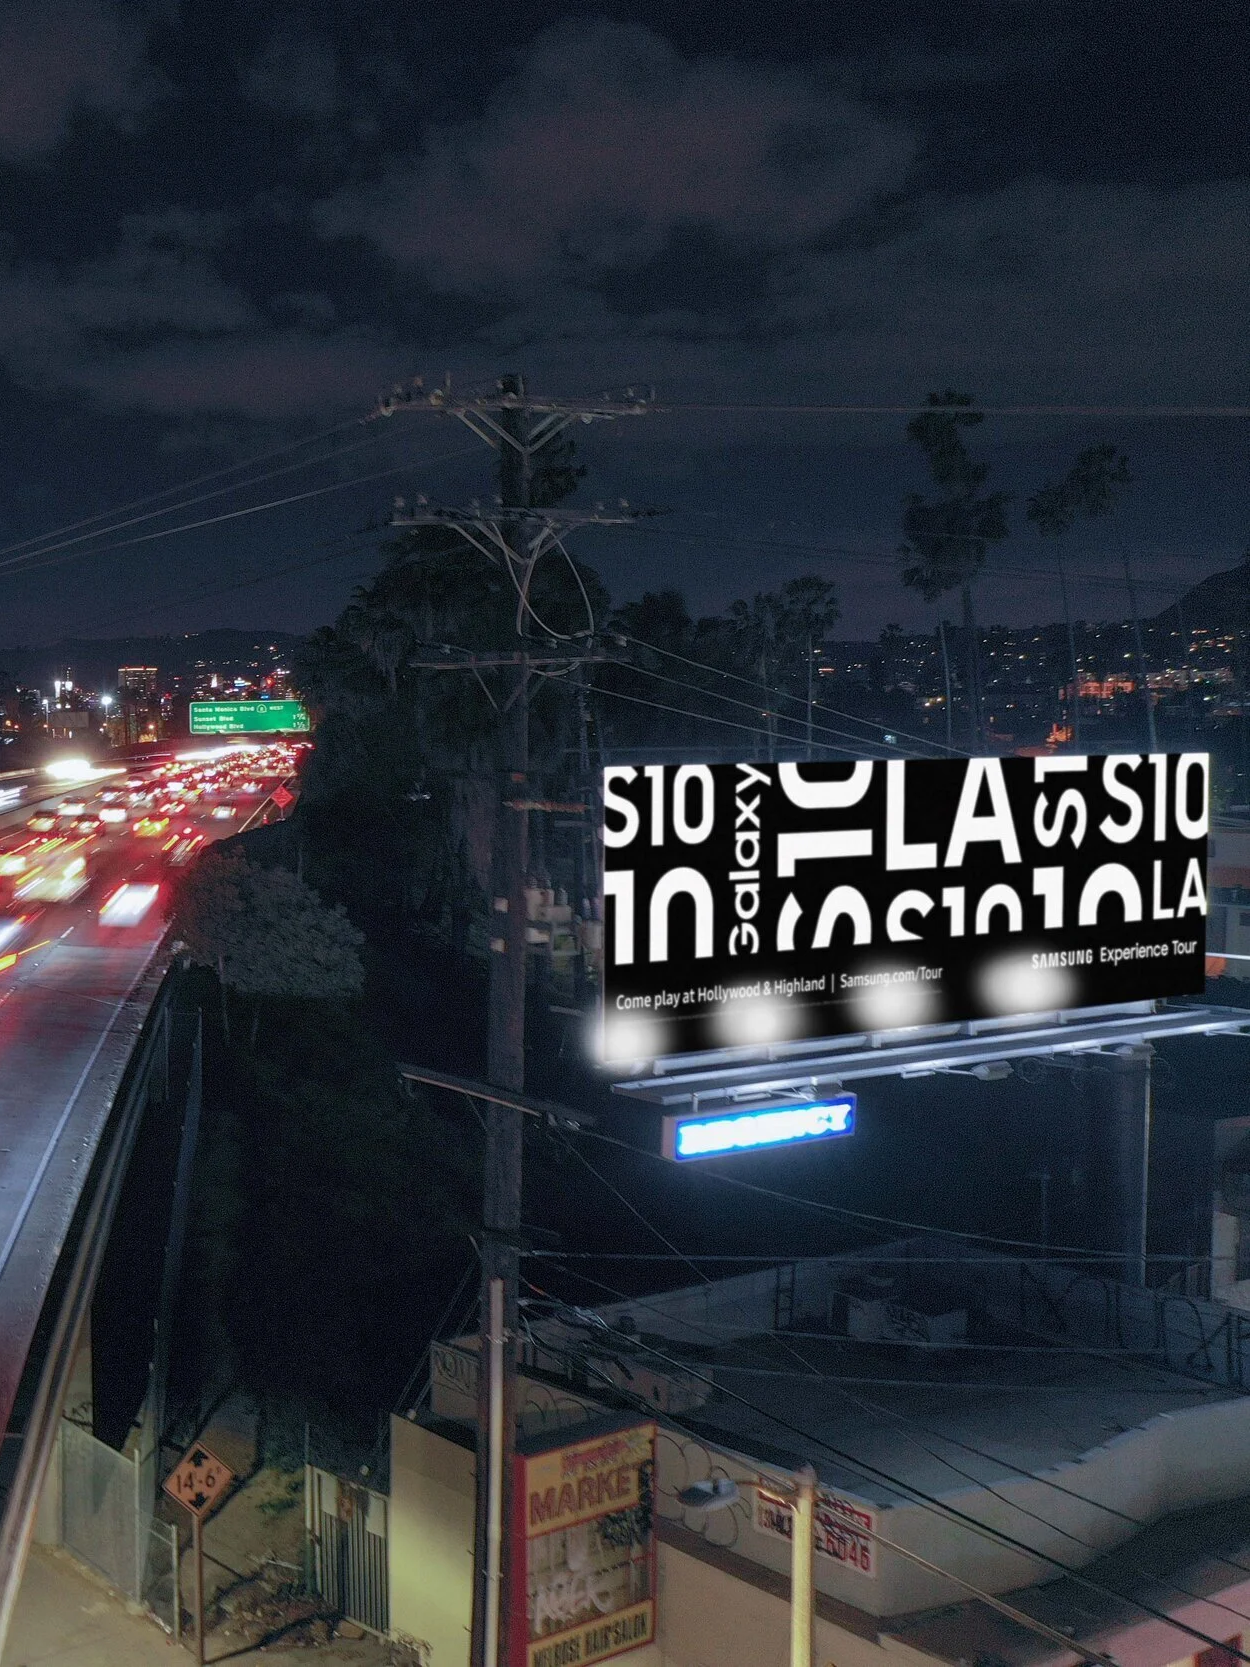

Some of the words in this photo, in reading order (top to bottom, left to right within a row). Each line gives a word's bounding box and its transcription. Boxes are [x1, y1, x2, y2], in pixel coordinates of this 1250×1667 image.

[193, 723, 227, 731] Hollywood
[603, 764, 714, 848] S10
[886, 758, 1022, 871] LA
[1099, 753, 1210, 844] S10
[729, 764, 771, 956] Galaxy
[1153, 858, 1207, 920] LA
[616, 994, 651, 1010] Come
[654, 990, 681, 1010] play
[682, 989, 695, 1004] at
[698, 981, 760, 1004] Hollywood
[763, 981, 771, 996] &
[774, 975, 825, 997] Highland
[840, 966, 943, 989] Samsung.com/Tour
[1032, 949, 1093, 970] SAMSUNG
[1100, 943, 1169, 966] Experience
[1172, 940, 1197, 956] Tour
